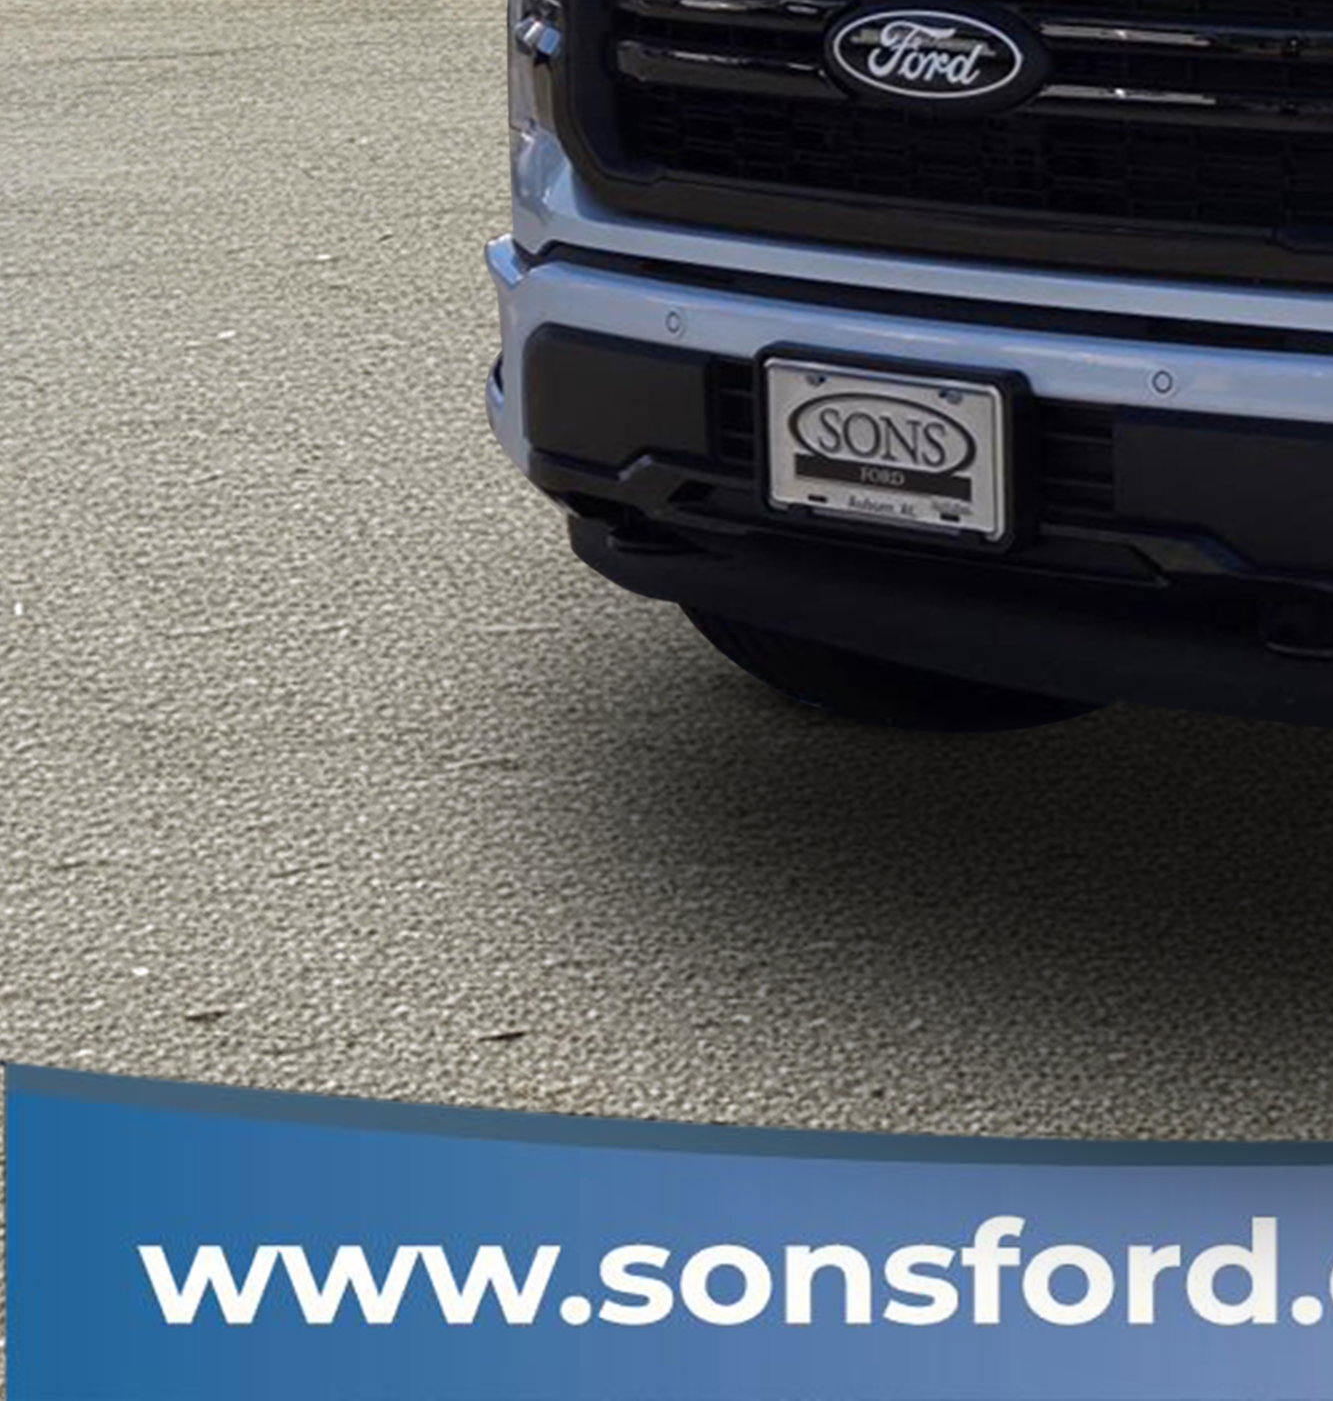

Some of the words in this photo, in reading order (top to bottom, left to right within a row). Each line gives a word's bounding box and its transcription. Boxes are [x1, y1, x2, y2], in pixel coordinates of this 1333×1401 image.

[867, 19, 982, 86] Ford
[817, 406, 948, 469] SONS
[858, 465, 906, 486] FORD
